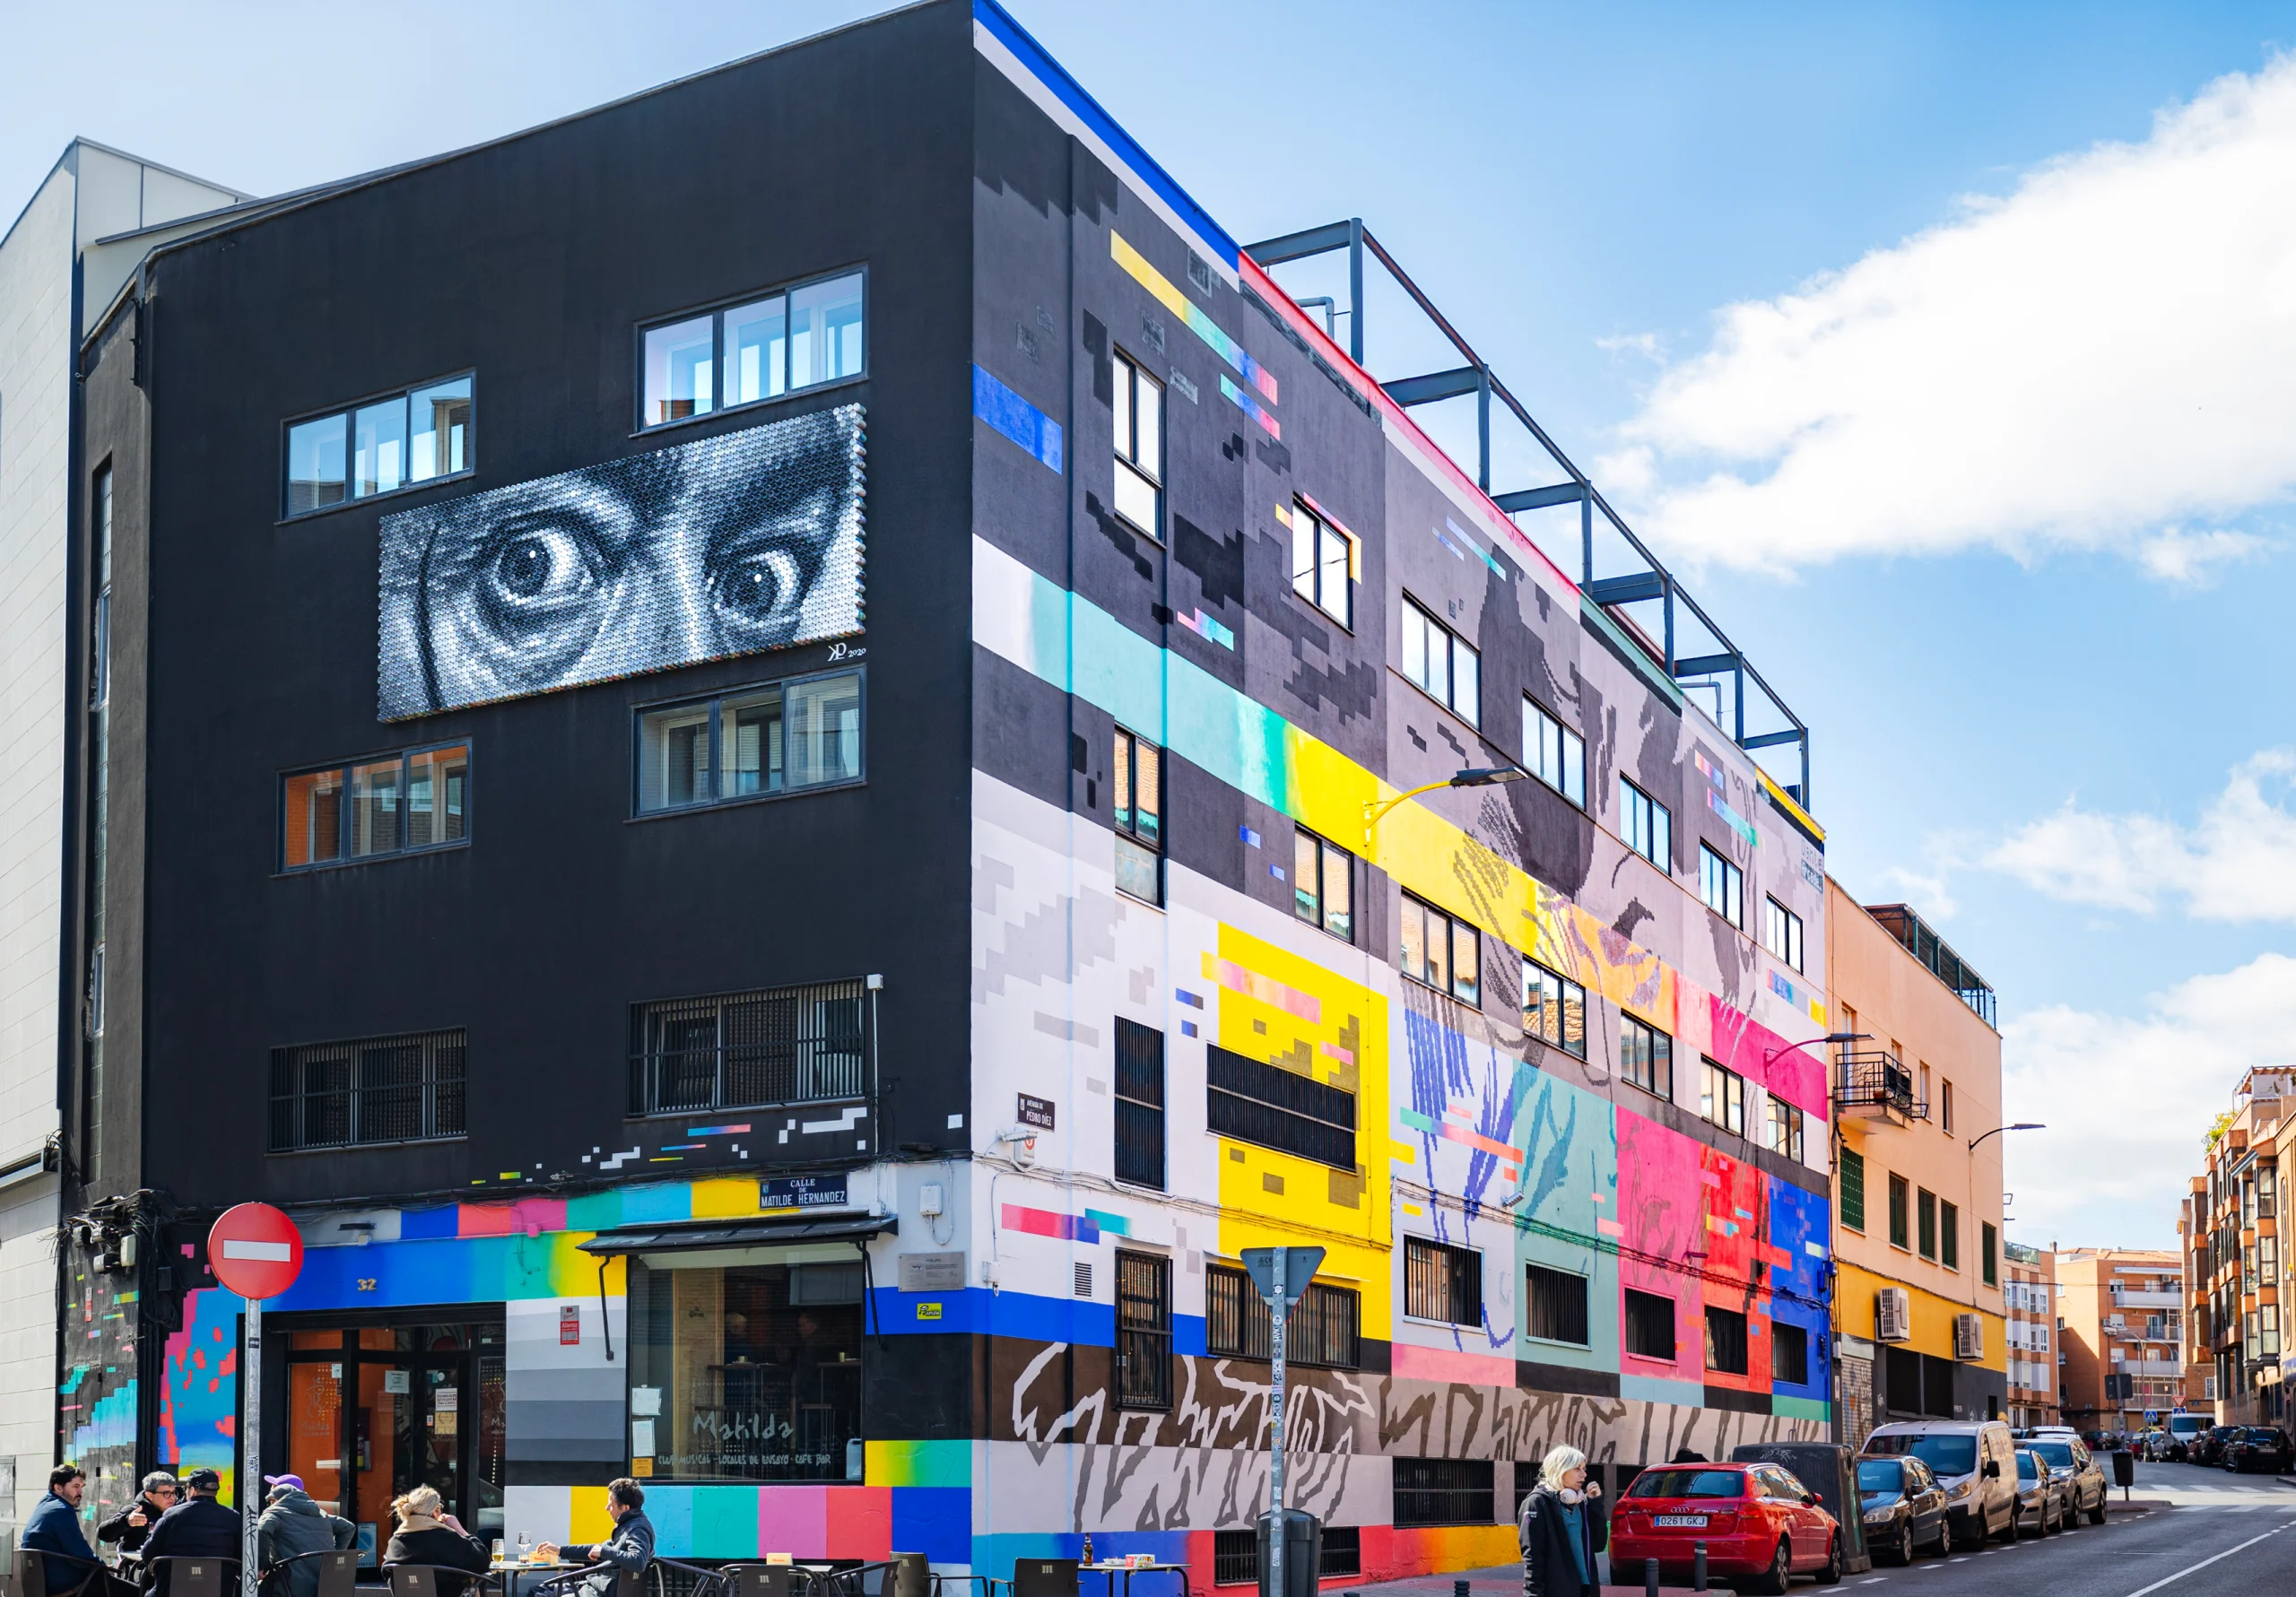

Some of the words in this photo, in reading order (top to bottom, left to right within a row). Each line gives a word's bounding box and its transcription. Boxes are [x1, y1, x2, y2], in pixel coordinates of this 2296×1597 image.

[848, 647, 866, 658] 2020
[1026, 1111, 1040, 1124] PEDRO
[1041, 1113, 1052, 1126] DÍEZ
[790, 1179, 815, 1187] CALLE
[761, 1194, 793, 1207] MATILDE
[798, 1191, 845, 1204] HERNANDEZ
[357, 1278, 378, 1291] 32
[692, 1410, 794, 1440] Matilda
[762, 1454, 789, 1465] ENSAYO
[816, 1454, 831, 1466] BAR
